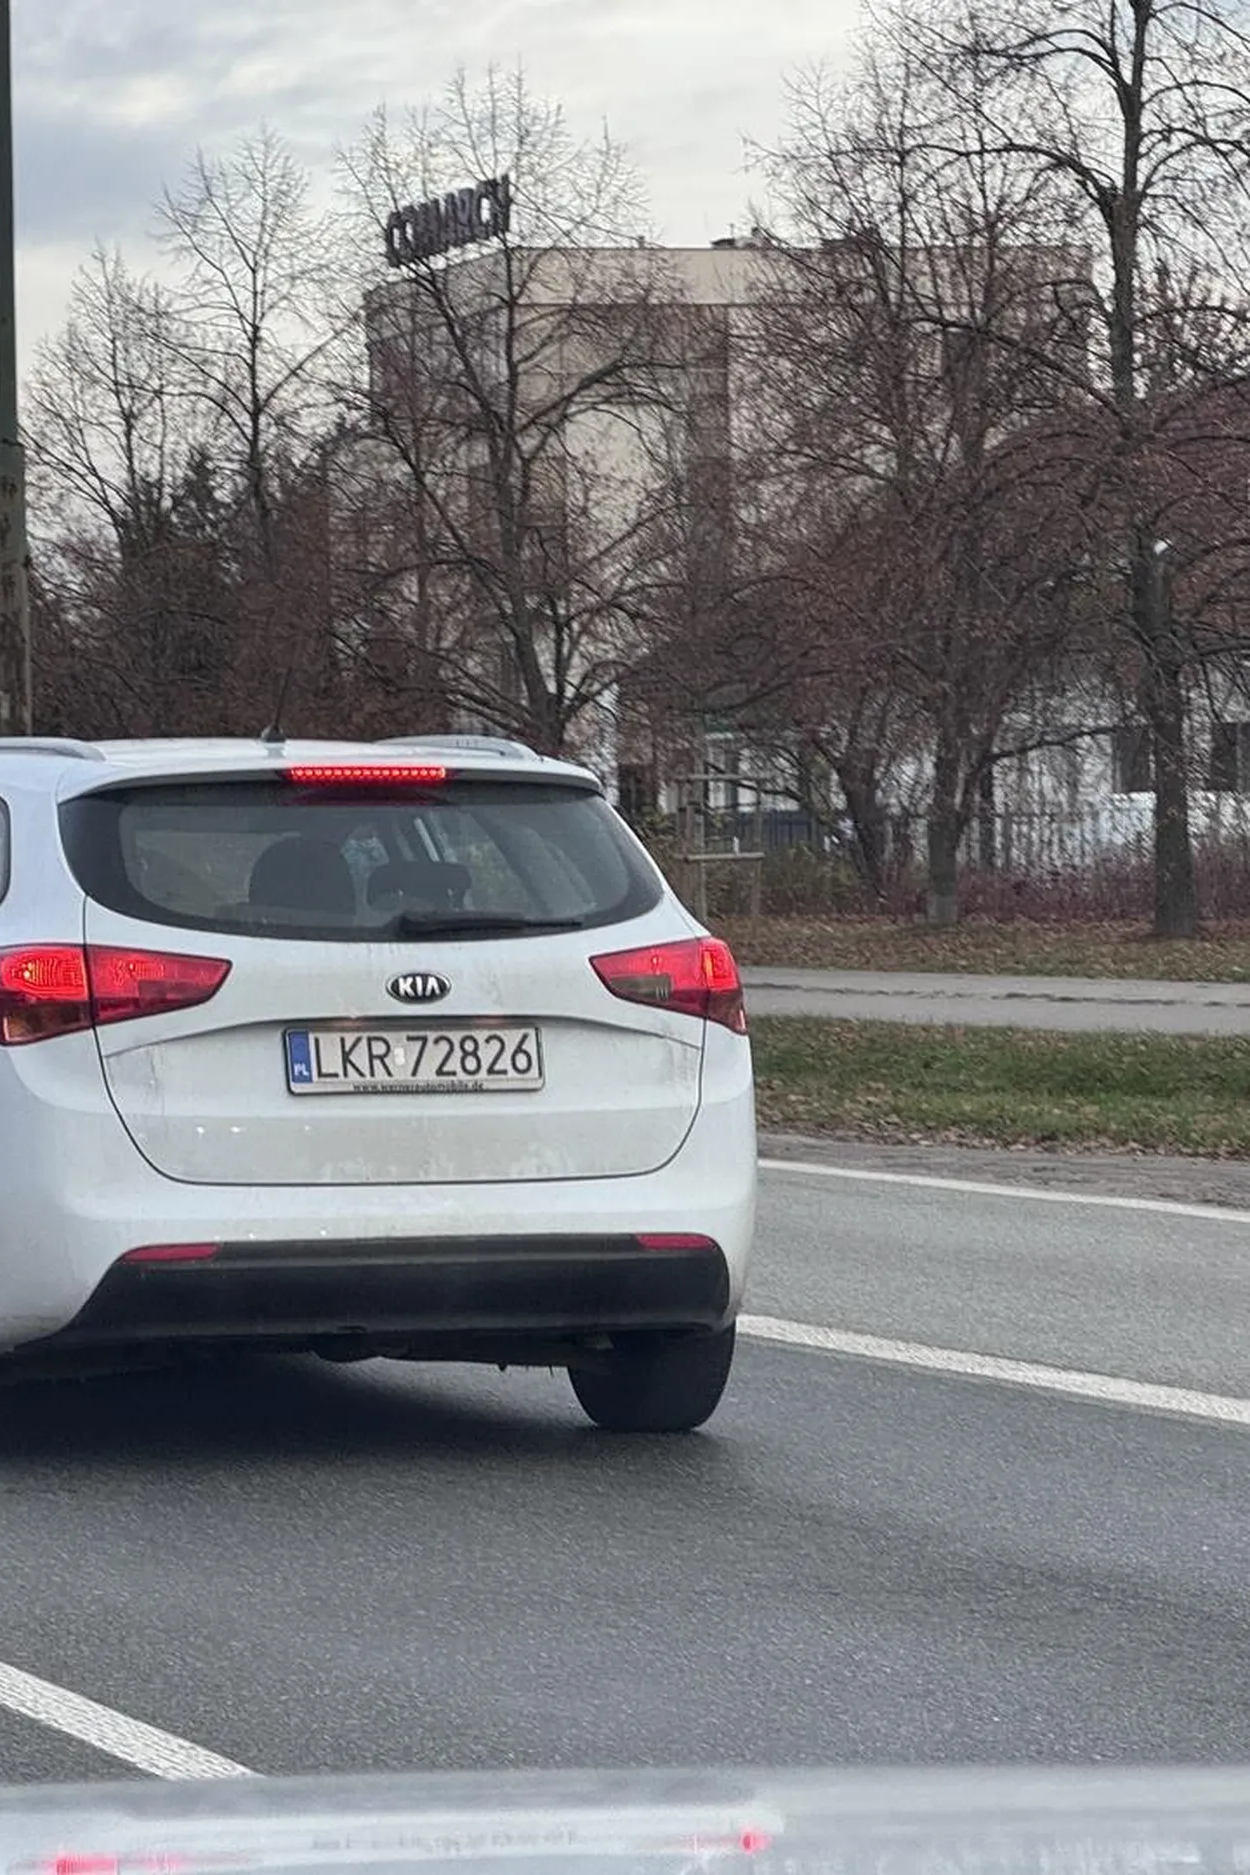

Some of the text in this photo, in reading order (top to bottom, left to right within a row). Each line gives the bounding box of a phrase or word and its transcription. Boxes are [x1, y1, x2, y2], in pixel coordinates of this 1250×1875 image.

[398, 976, 441, 997] KIA
[314, 1033, 534, 1079] LKR 72826
[294, 1063, 310, 1077] PL
